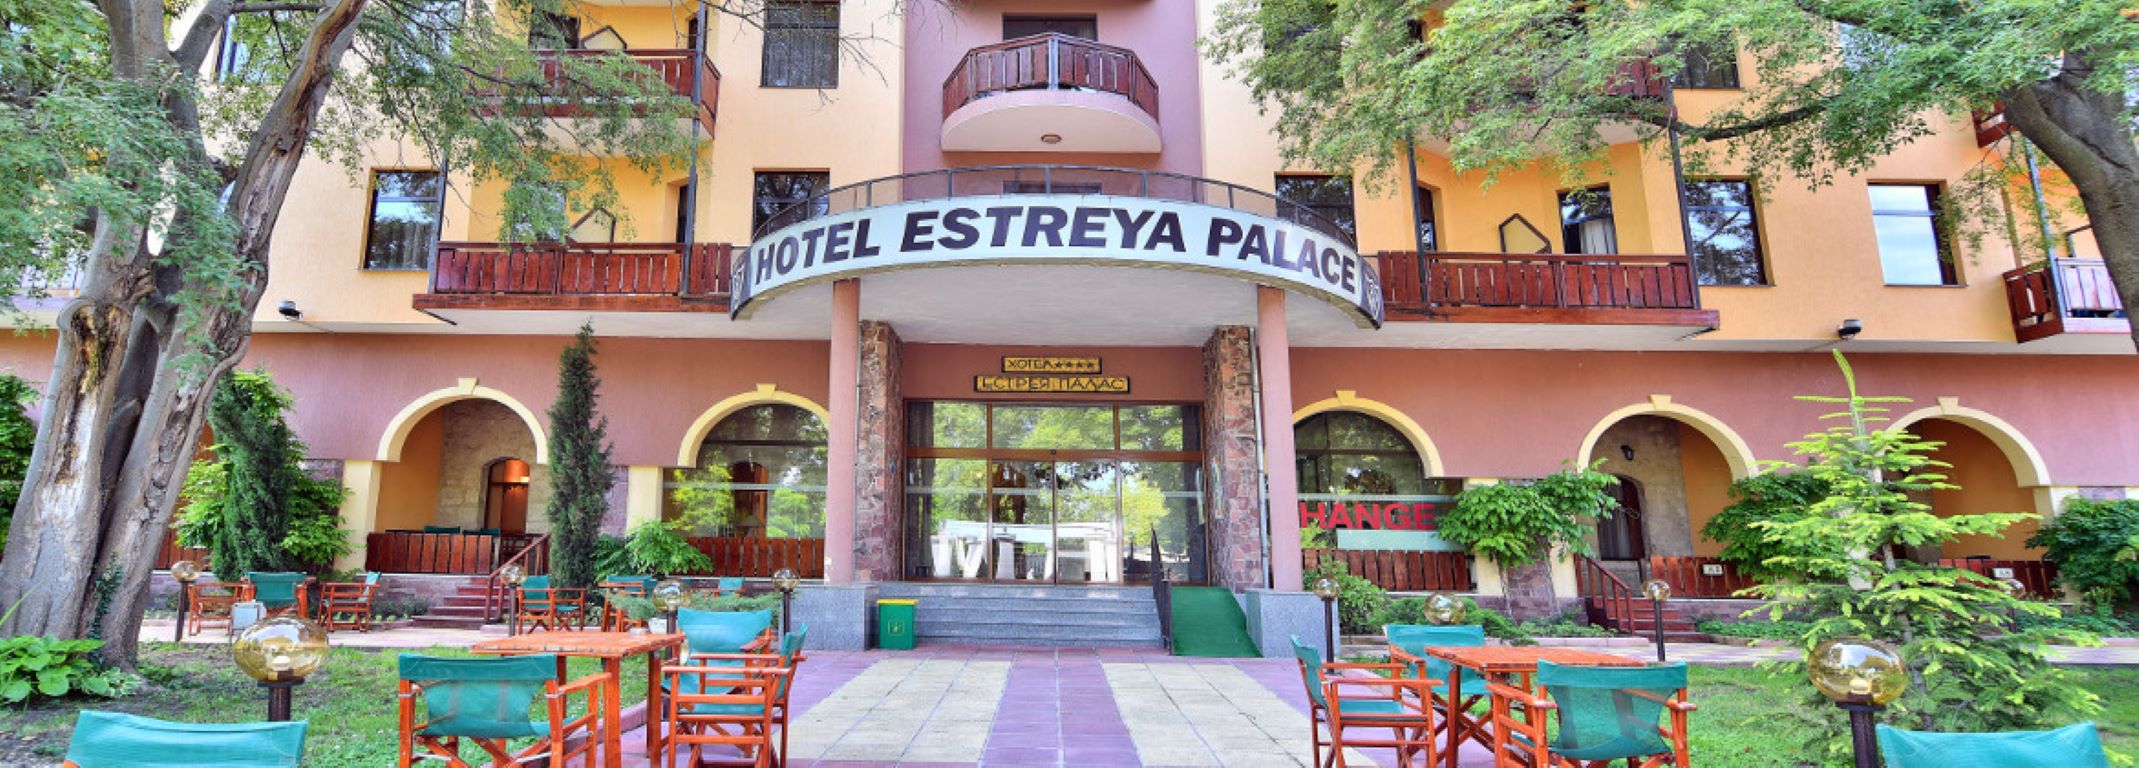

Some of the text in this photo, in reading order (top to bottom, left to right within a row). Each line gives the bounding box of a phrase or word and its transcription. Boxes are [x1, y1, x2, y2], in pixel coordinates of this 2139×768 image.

[755, 205, 1356, 295] HOTEL ESTREYA PALACE
[1008, 358, 1053, 370] ХОТЕЛ
